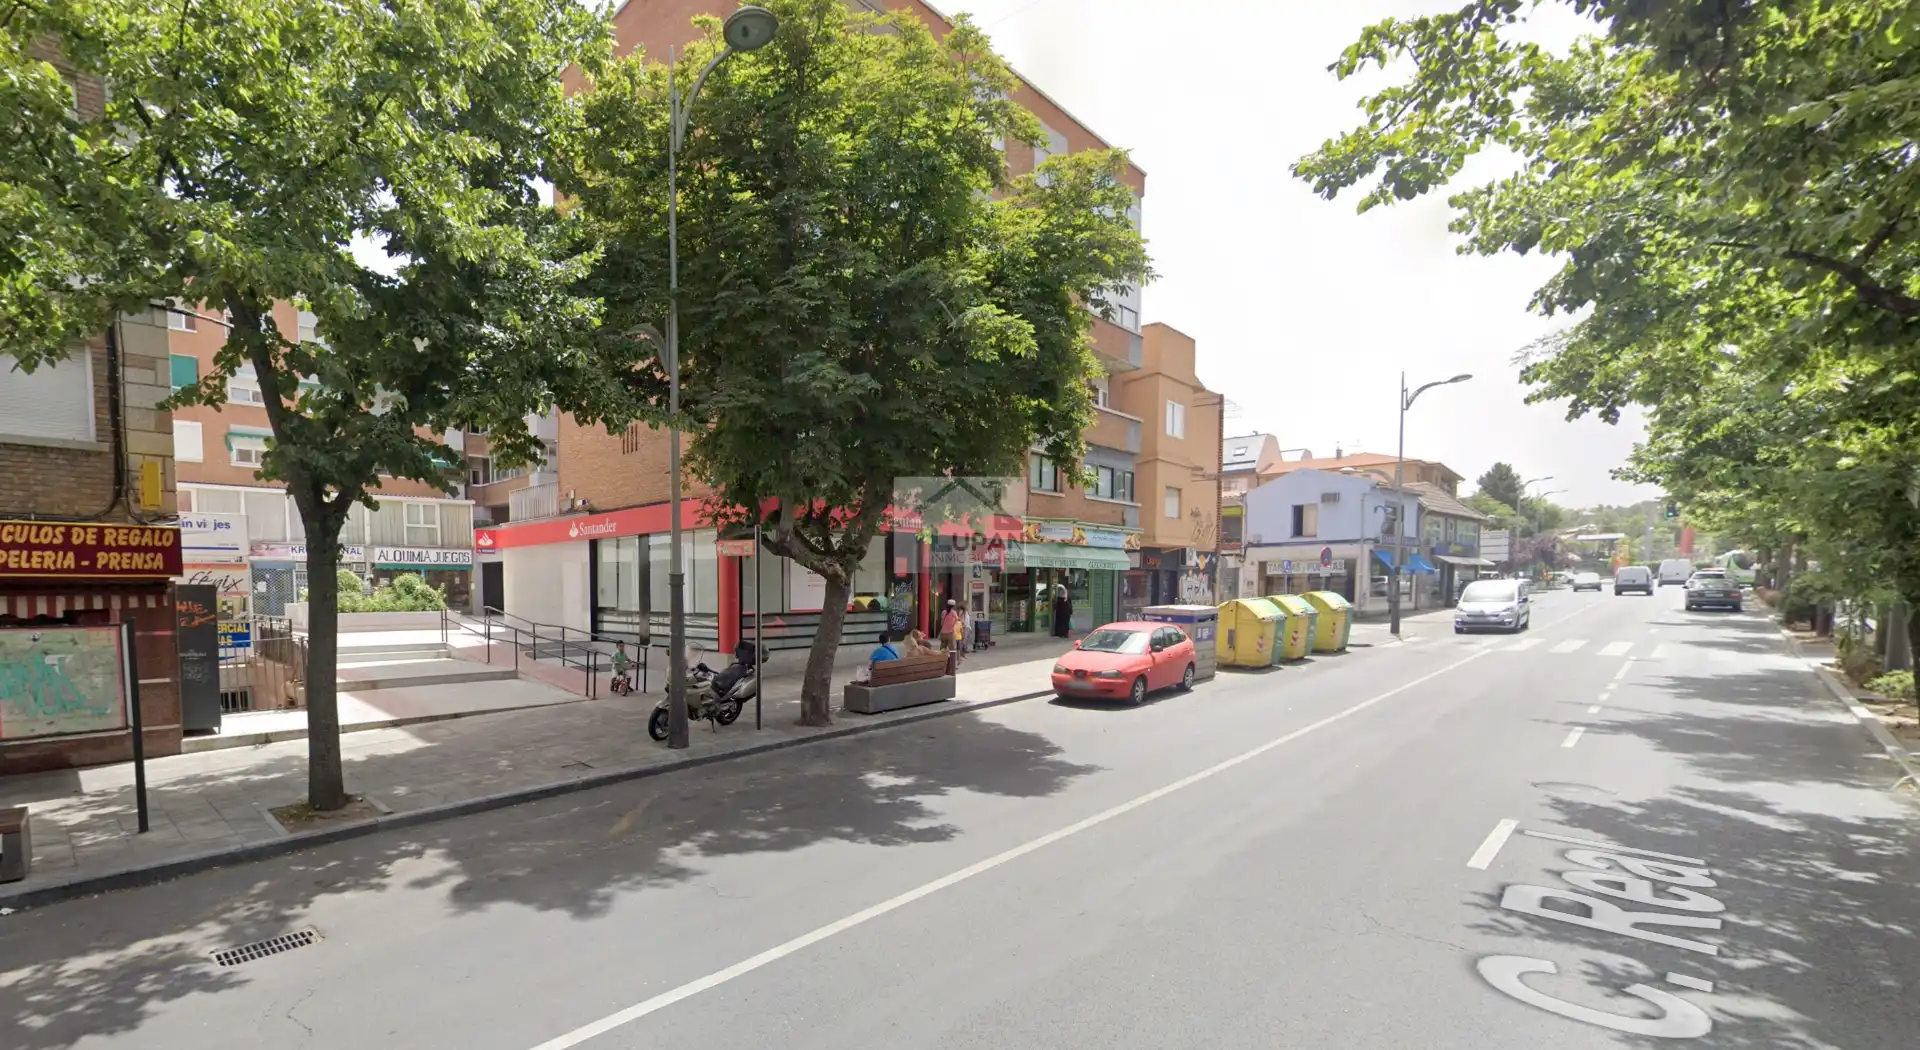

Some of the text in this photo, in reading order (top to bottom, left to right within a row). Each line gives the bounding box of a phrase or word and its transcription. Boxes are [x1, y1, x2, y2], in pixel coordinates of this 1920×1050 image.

[0, 525, 174, 547] CULOS DE REGALO
[579, 518, 617, 537] Santander
[96, 551, 164, 571] PRENSA
[378, 549, 471, 563] ALQUIMIA JUEGOS
[218, 635, 233, 646] AS
